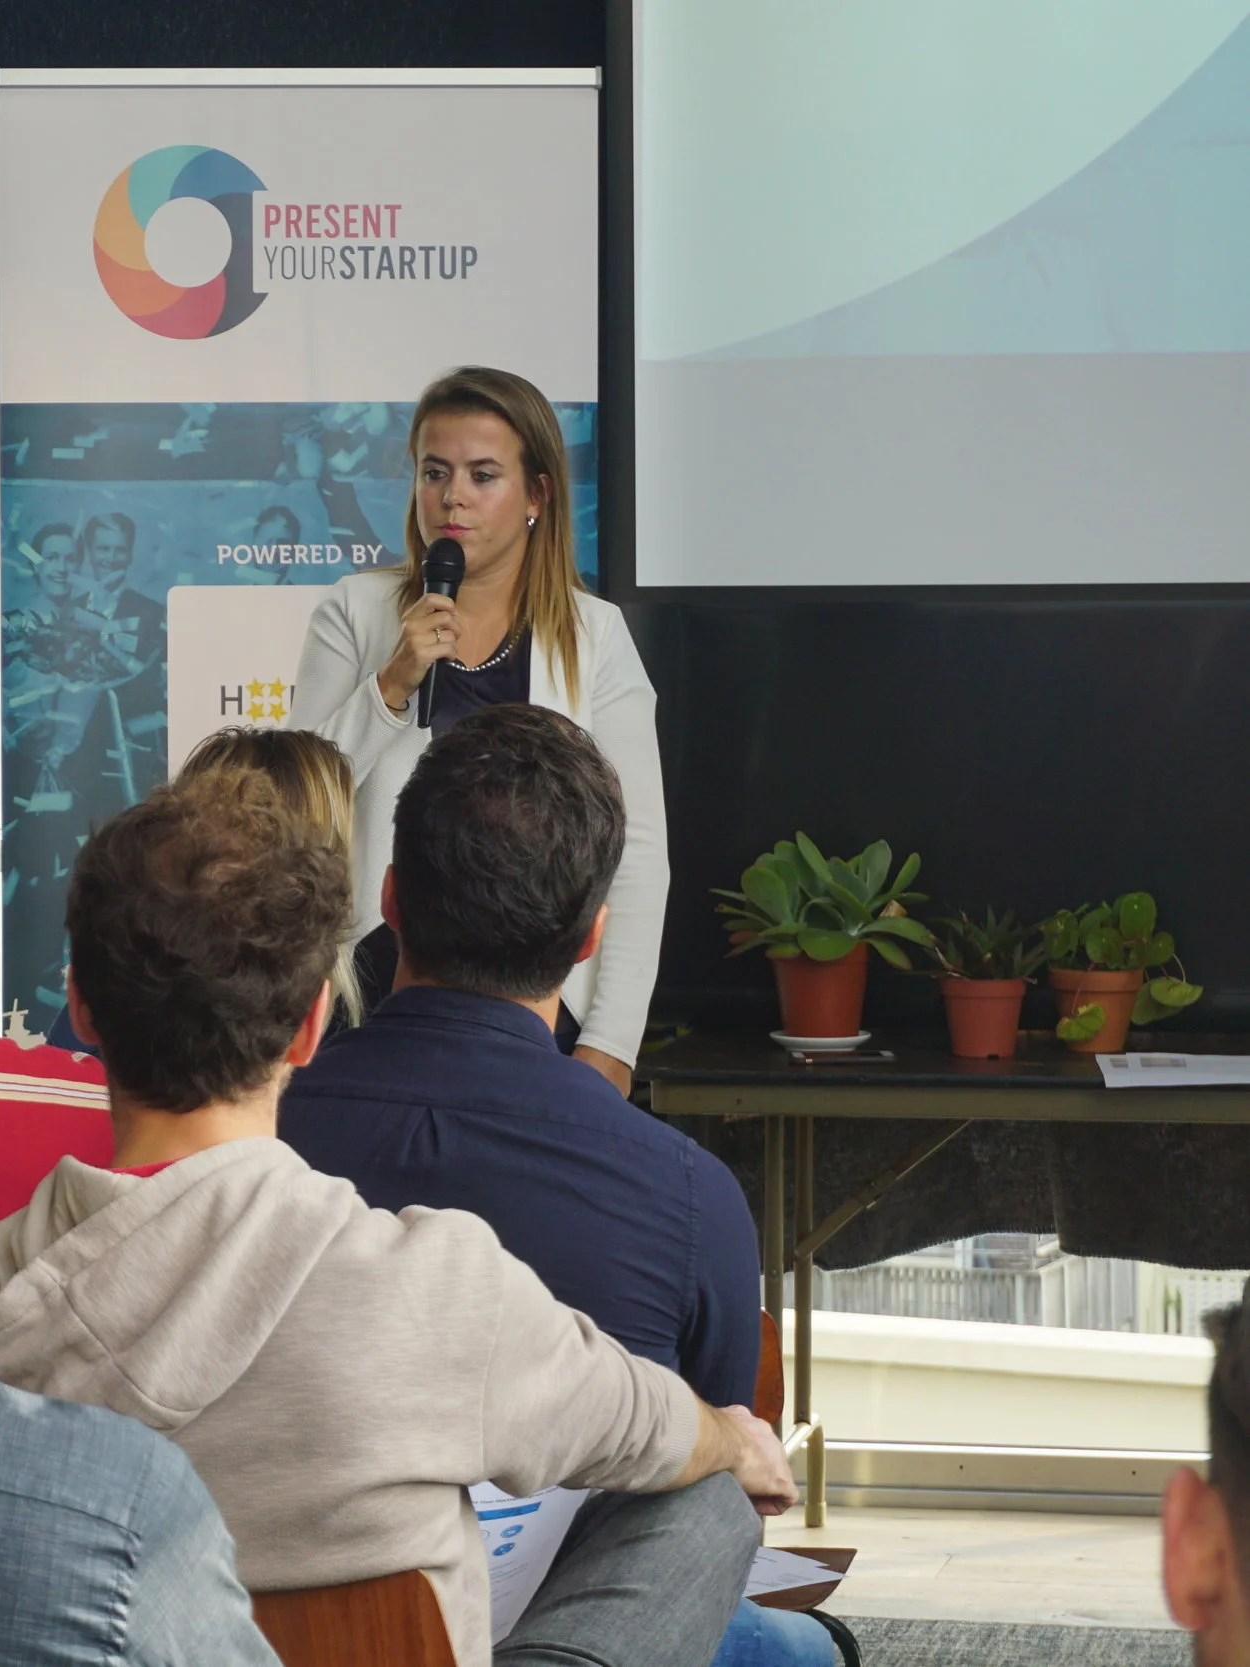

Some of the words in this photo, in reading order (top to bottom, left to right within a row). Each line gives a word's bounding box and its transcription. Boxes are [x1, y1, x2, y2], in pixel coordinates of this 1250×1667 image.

[264, 204, 402, 239] PRESENT
[264, 245, 478, 280] YOURSTARTUP
[217, 544, 343, 565] POWERED
[351, 544, 383, 565] BY
